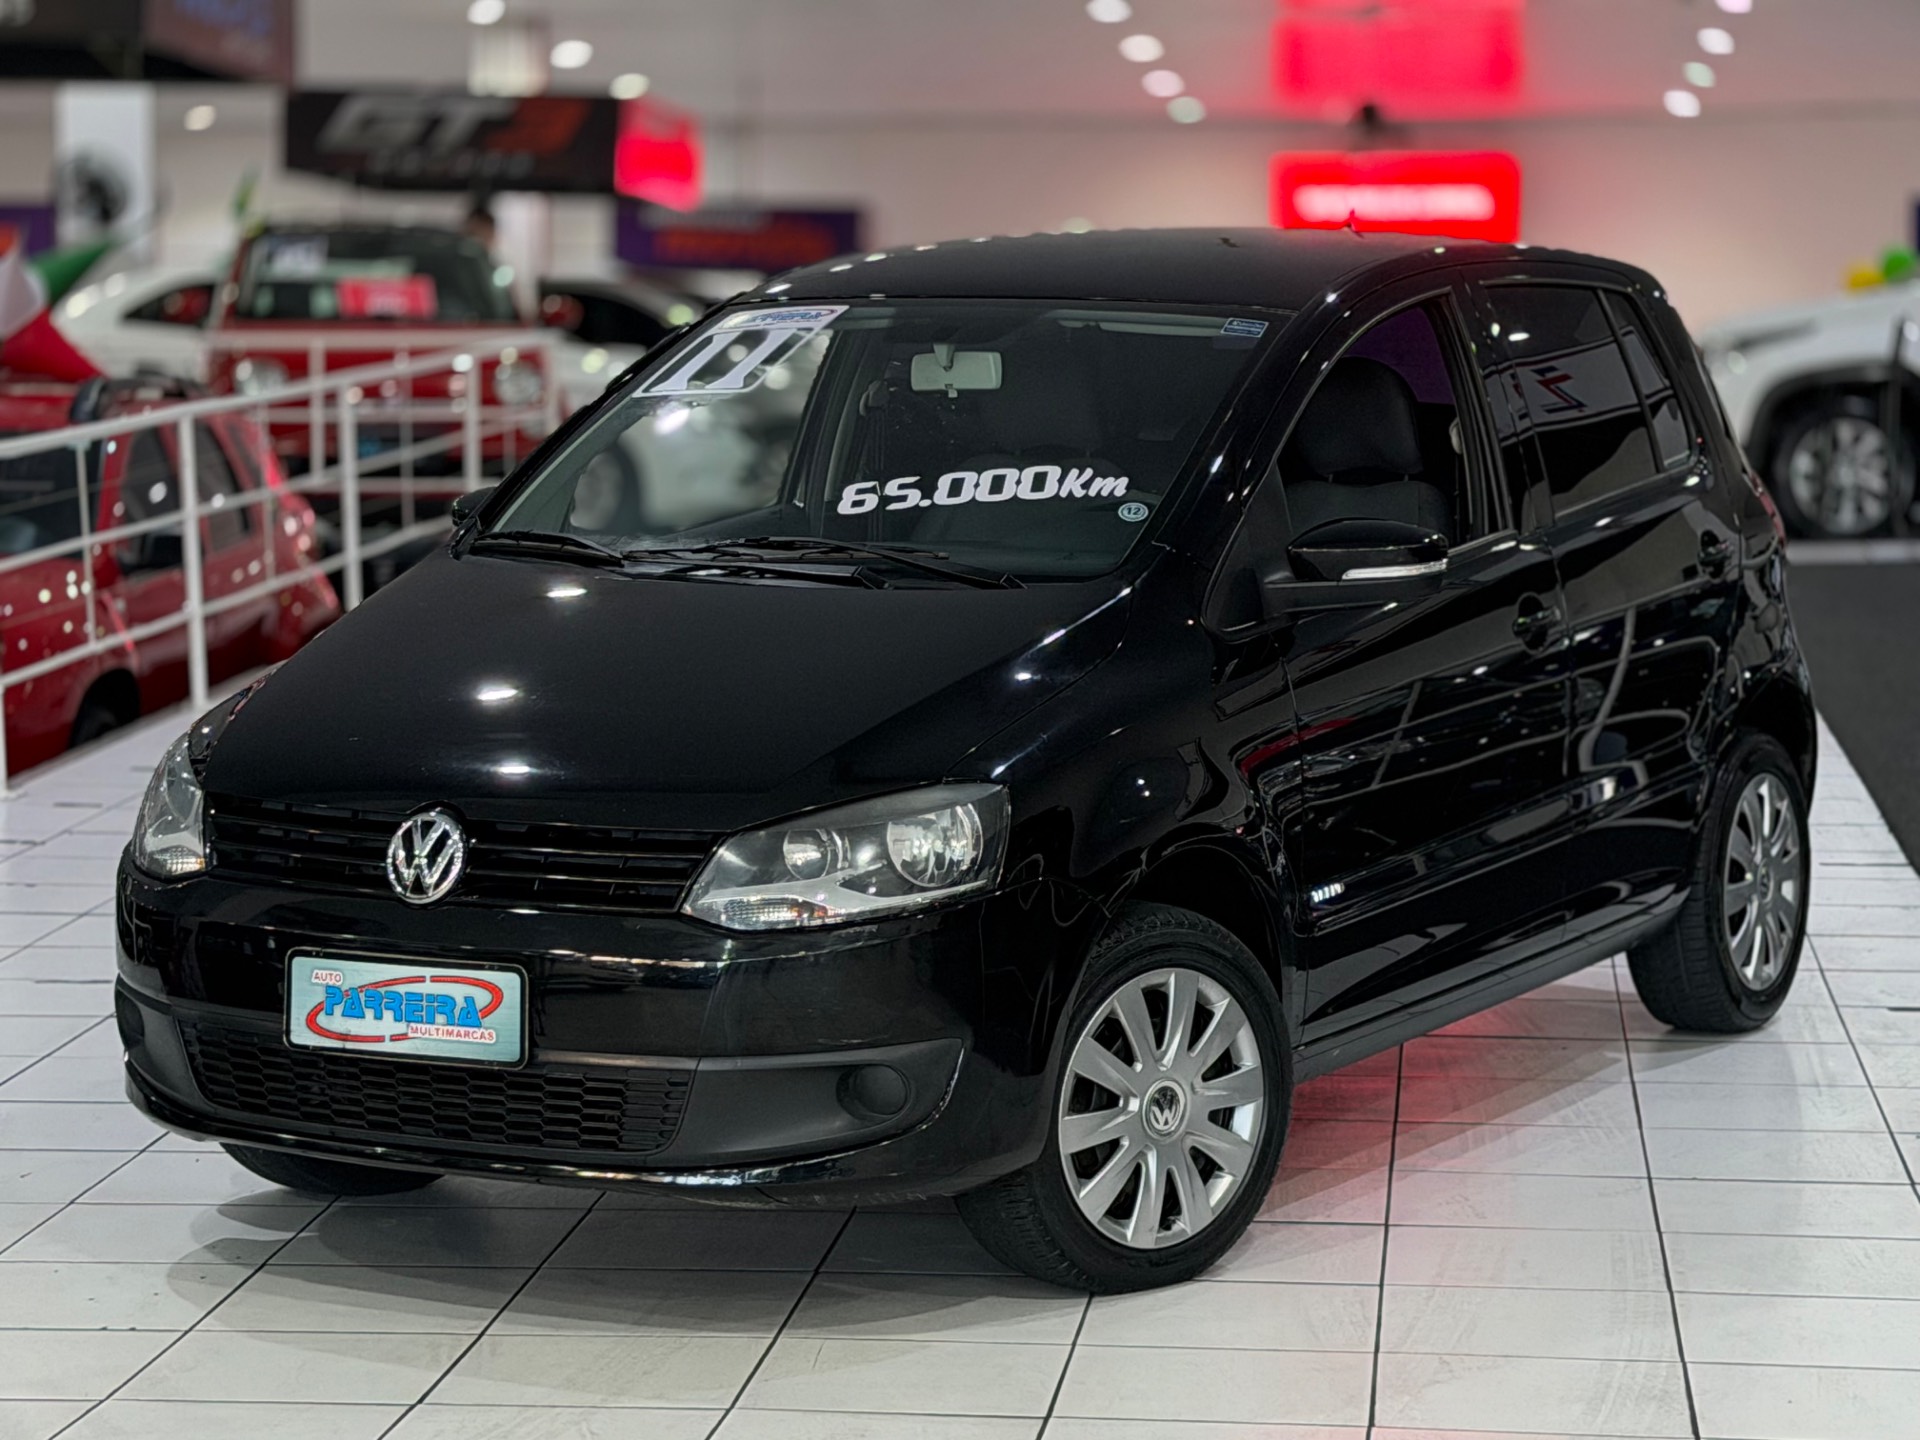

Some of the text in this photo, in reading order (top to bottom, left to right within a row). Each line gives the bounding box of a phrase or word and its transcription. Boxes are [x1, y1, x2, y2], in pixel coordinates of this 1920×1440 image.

[836, 465, 1130, 515] 65.000Km
[1126, 506, 1141, 516] 12
[389, 815, 461, 900] VW
[313, 971, 342, 983] AUTO
[324, 985, 482, 1028] PARREIRA
[409, 1025, 495, 1041] MULTIMARCAS
